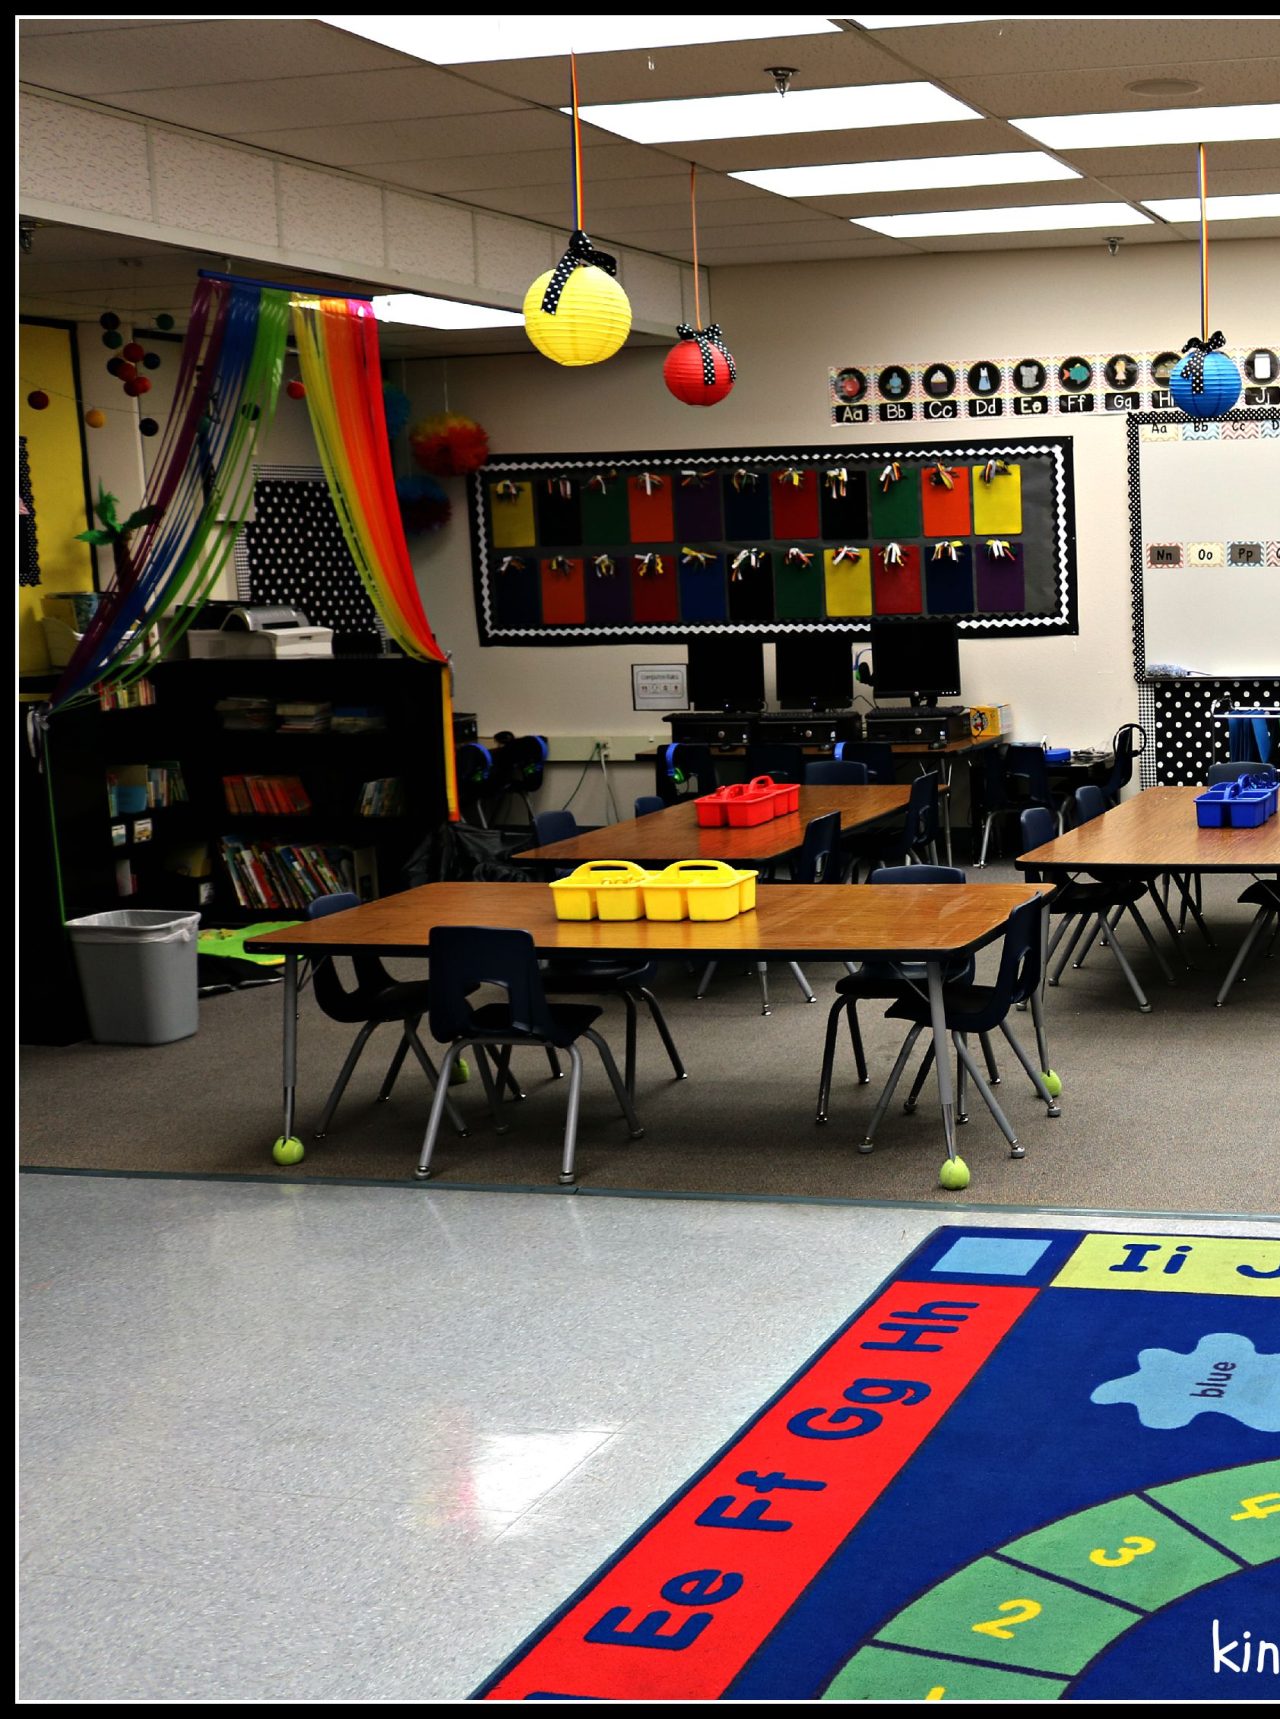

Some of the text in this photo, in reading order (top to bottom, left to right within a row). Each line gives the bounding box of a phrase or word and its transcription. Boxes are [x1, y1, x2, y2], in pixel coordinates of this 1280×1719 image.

[842, 405, 863, 421] Aa
[886, 403, 907, 419] Bb
[928, 401, 953, 418] Cc
[975, 398, 996, 415] Dd
[1020, 397, 1042, 414] Ee
[1067, 395, 1087, 411] Ff
[1113, 394, 1132, 410] Gg
[1255, 388, 1271, 405] Jj
[1151, 423, 1168, 434] Aa
[1193, 420, 1208, 432] Bb
[1231, 421, 1246, 432] Cc
[1156, 549, 1173, 561] Nn
[1198, 549, 1213, 561] Oo
[1238, 548, 1253, 562] Pp
[1109, 1243, 1191, 1274] Ii
[1189, 1361, 1236, 1398] blue
[583, 1300, 980, 1651] Ee Ff Gg Hh
[973, 1599, 1042, 1640] 2
[1089, 1535, 1156, 1567] 3
